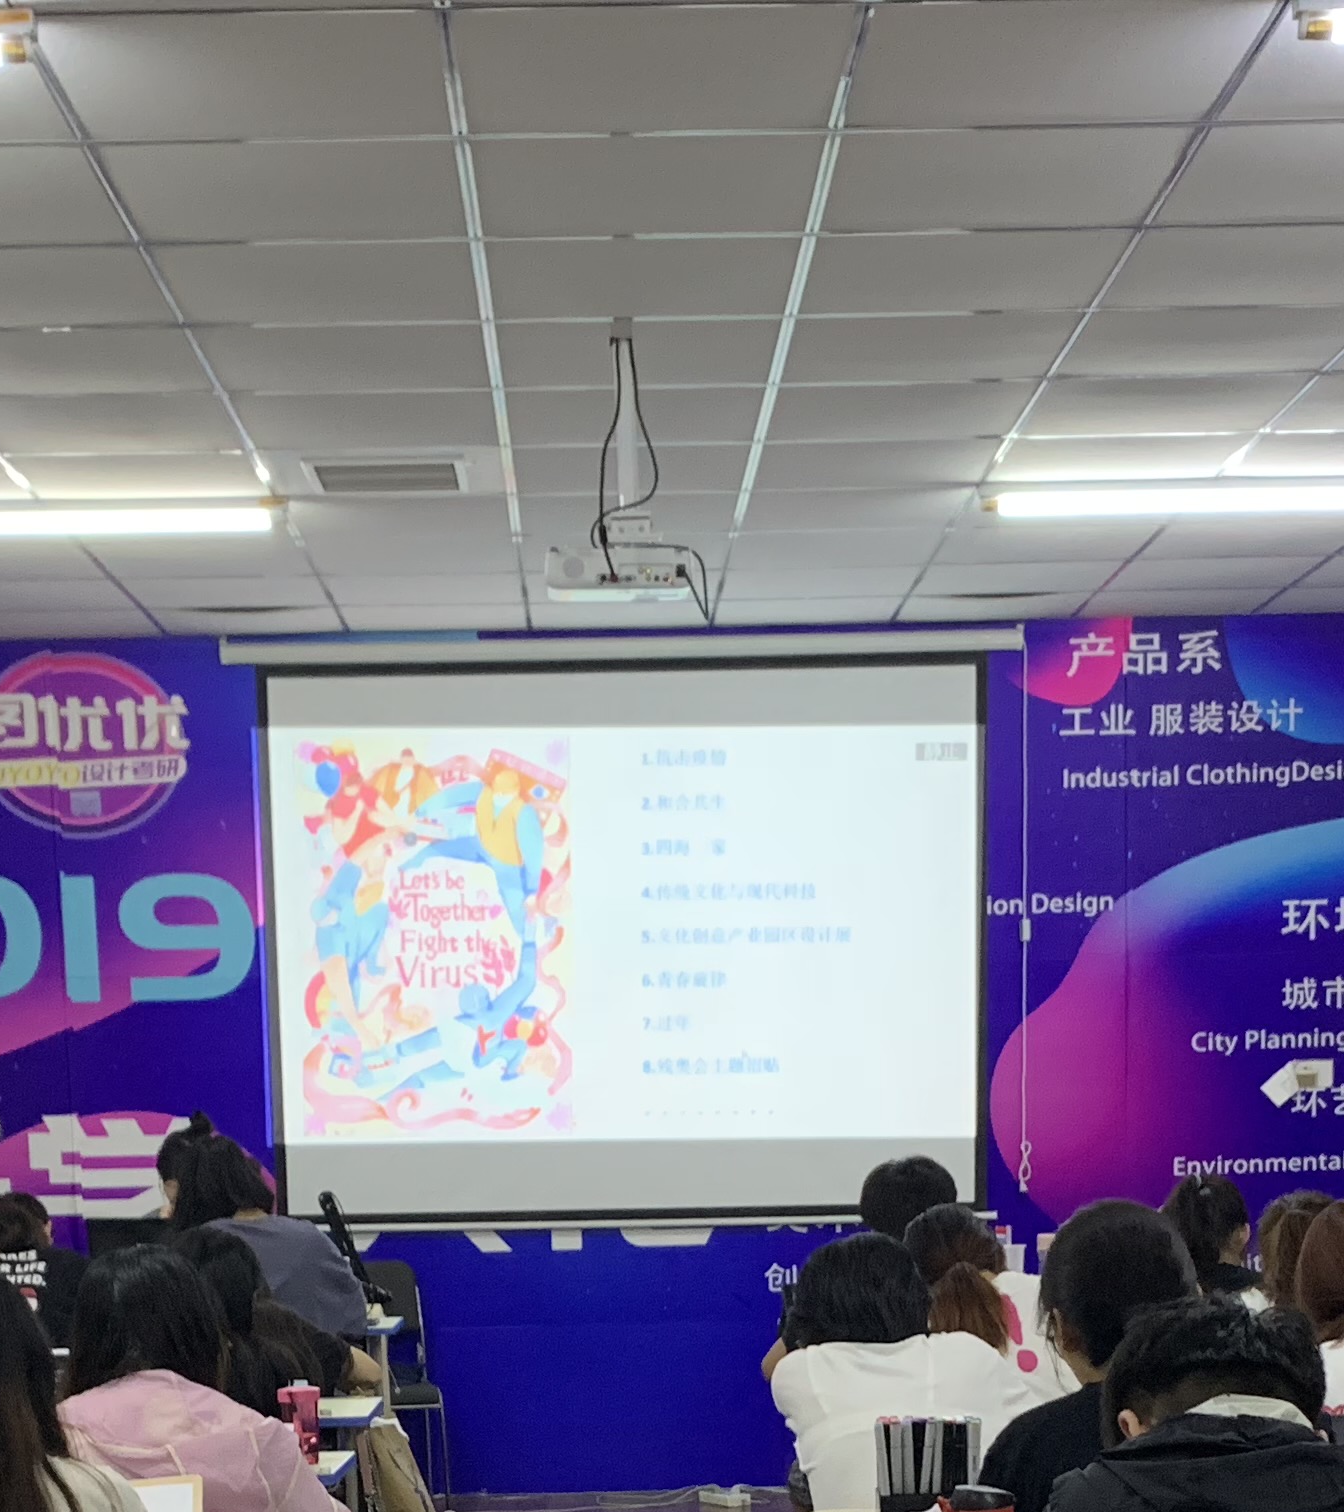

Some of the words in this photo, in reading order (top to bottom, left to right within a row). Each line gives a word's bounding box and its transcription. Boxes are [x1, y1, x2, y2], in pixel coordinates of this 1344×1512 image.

[1065, 629, 1223, 678] 产品系
[1059, 706, 1137, 738] 工业
[1149, 698, 1305, 738] 服装设计
[1062, 764, 1181, 790] Industrial
[445, 869, 466, 890] be
[404, 893, 486, 930] Together
[1031, 892, 1115, 918] Design
[400, 930, 458, 962] Fight
[395, 955, 479, 989] Virus
[1191, 1031, 1238, 1056] City
